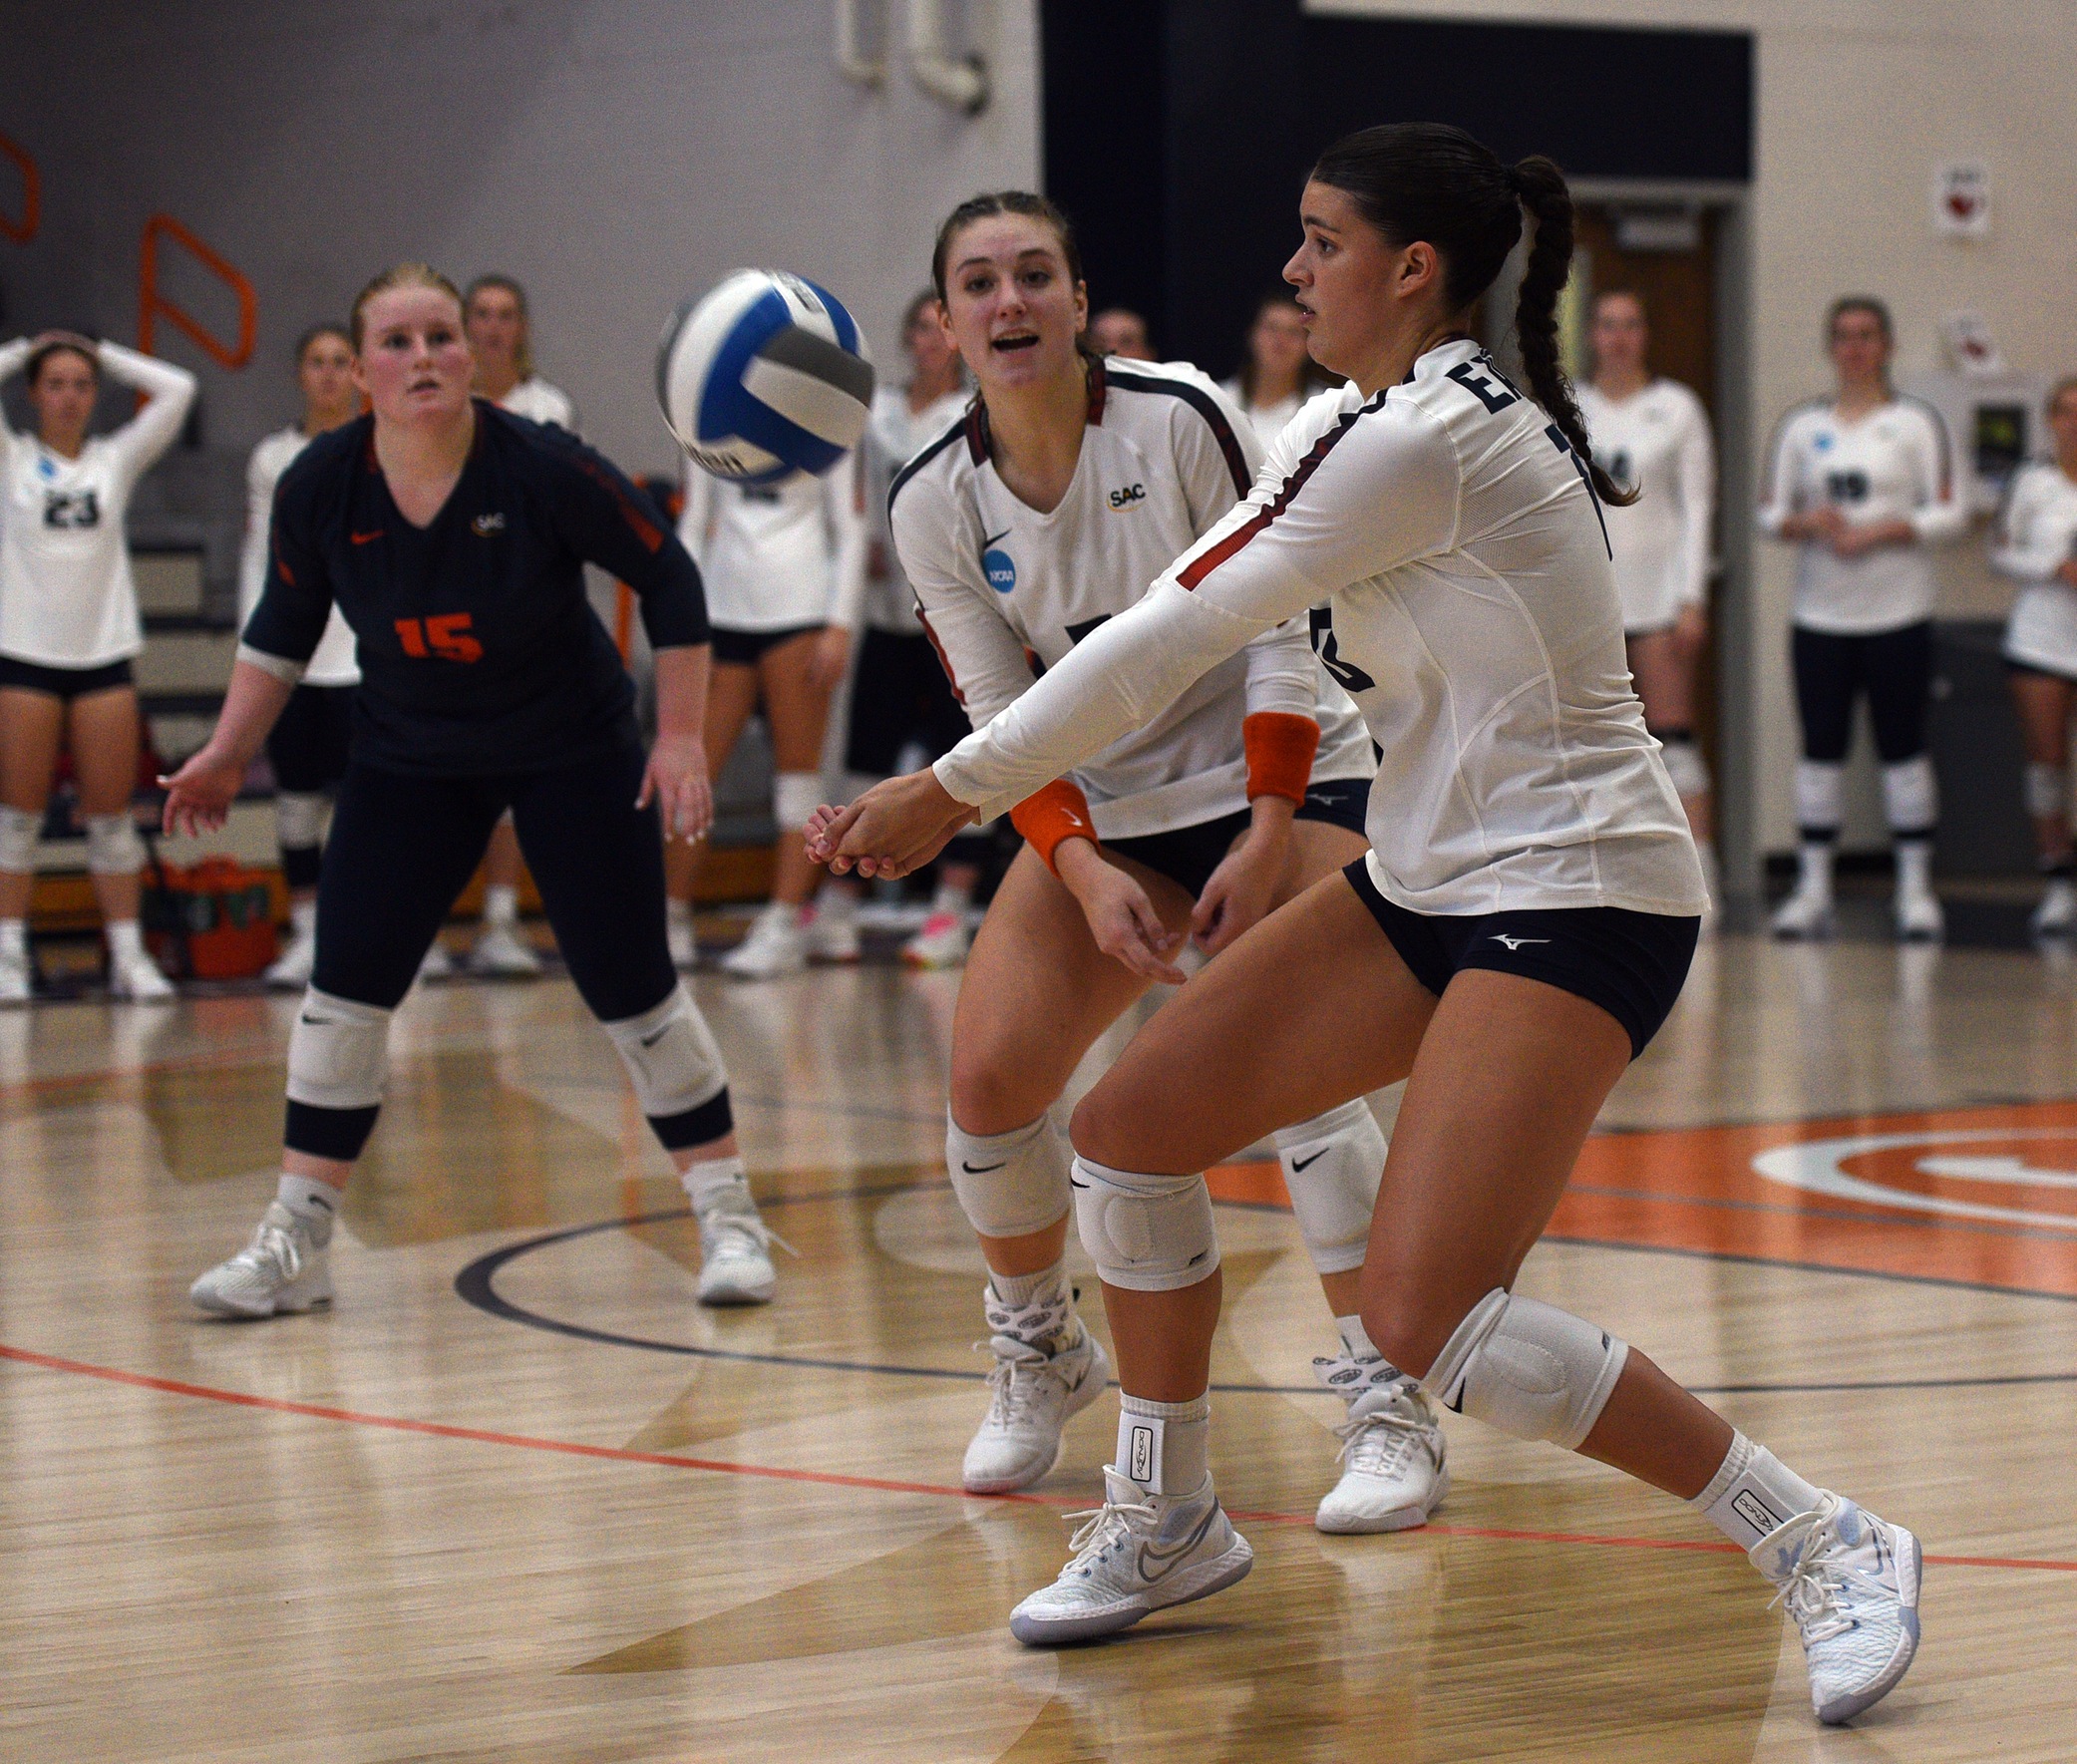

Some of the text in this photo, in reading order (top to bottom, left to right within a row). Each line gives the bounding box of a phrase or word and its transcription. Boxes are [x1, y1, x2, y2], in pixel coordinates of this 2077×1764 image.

[1110, 484, 1146, 507] SAC
[989, 569, 1014, 582] NCAA
[394, 611, 484, 664] 15
[1136, 1430, 1146, 1479] DONJOY
